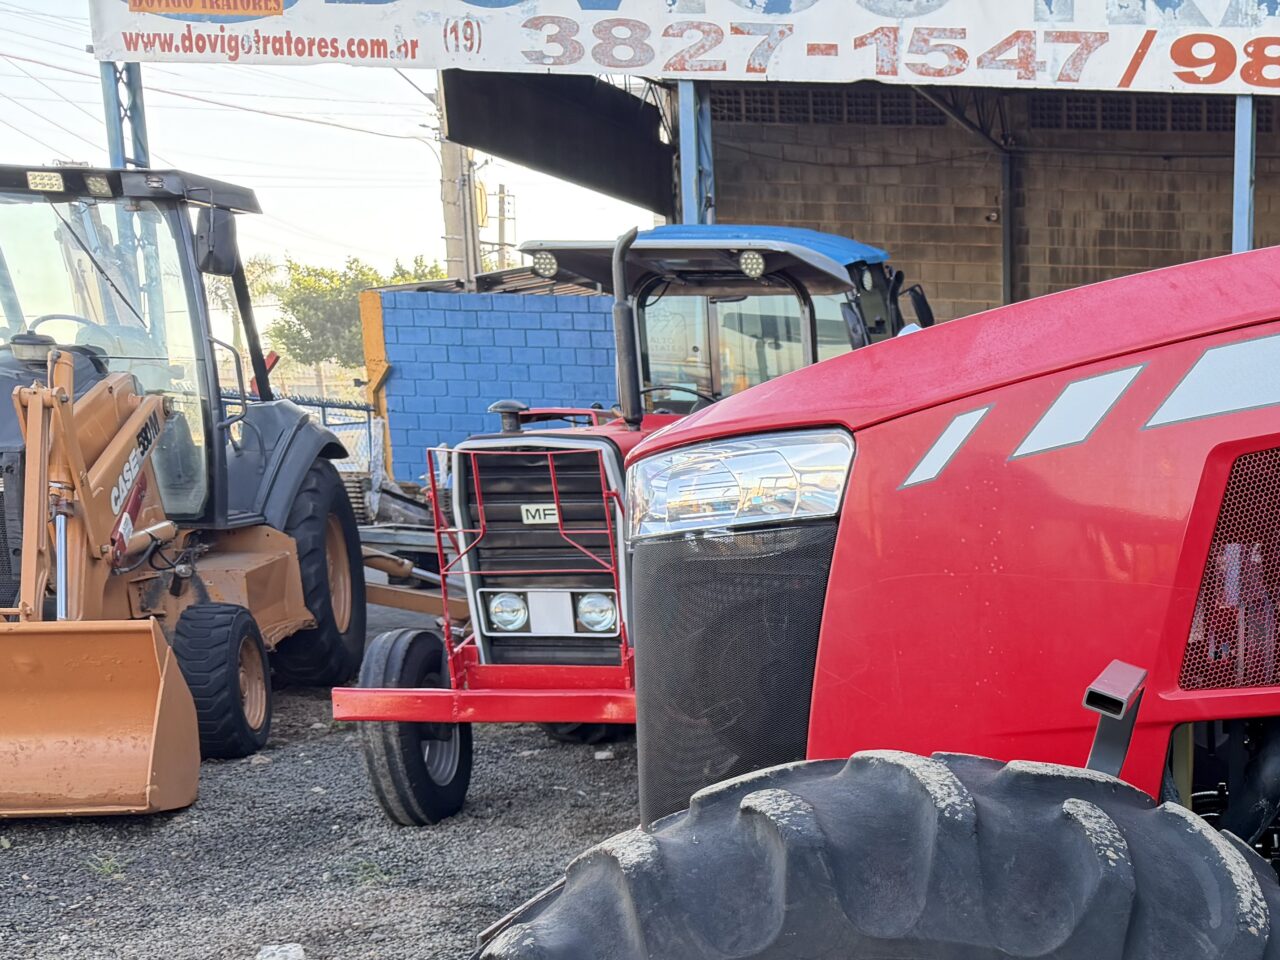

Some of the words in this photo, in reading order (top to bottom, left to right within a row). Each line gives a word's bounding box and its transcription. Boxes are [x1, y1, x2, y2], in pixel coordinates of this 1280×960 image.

[121, 25, 419, 61] www.dovigotratores.com.br
[443, 20, 482, 54] (19)
[111, 448, 140, 515] CASE
[525, 508, 556, 520] MF
